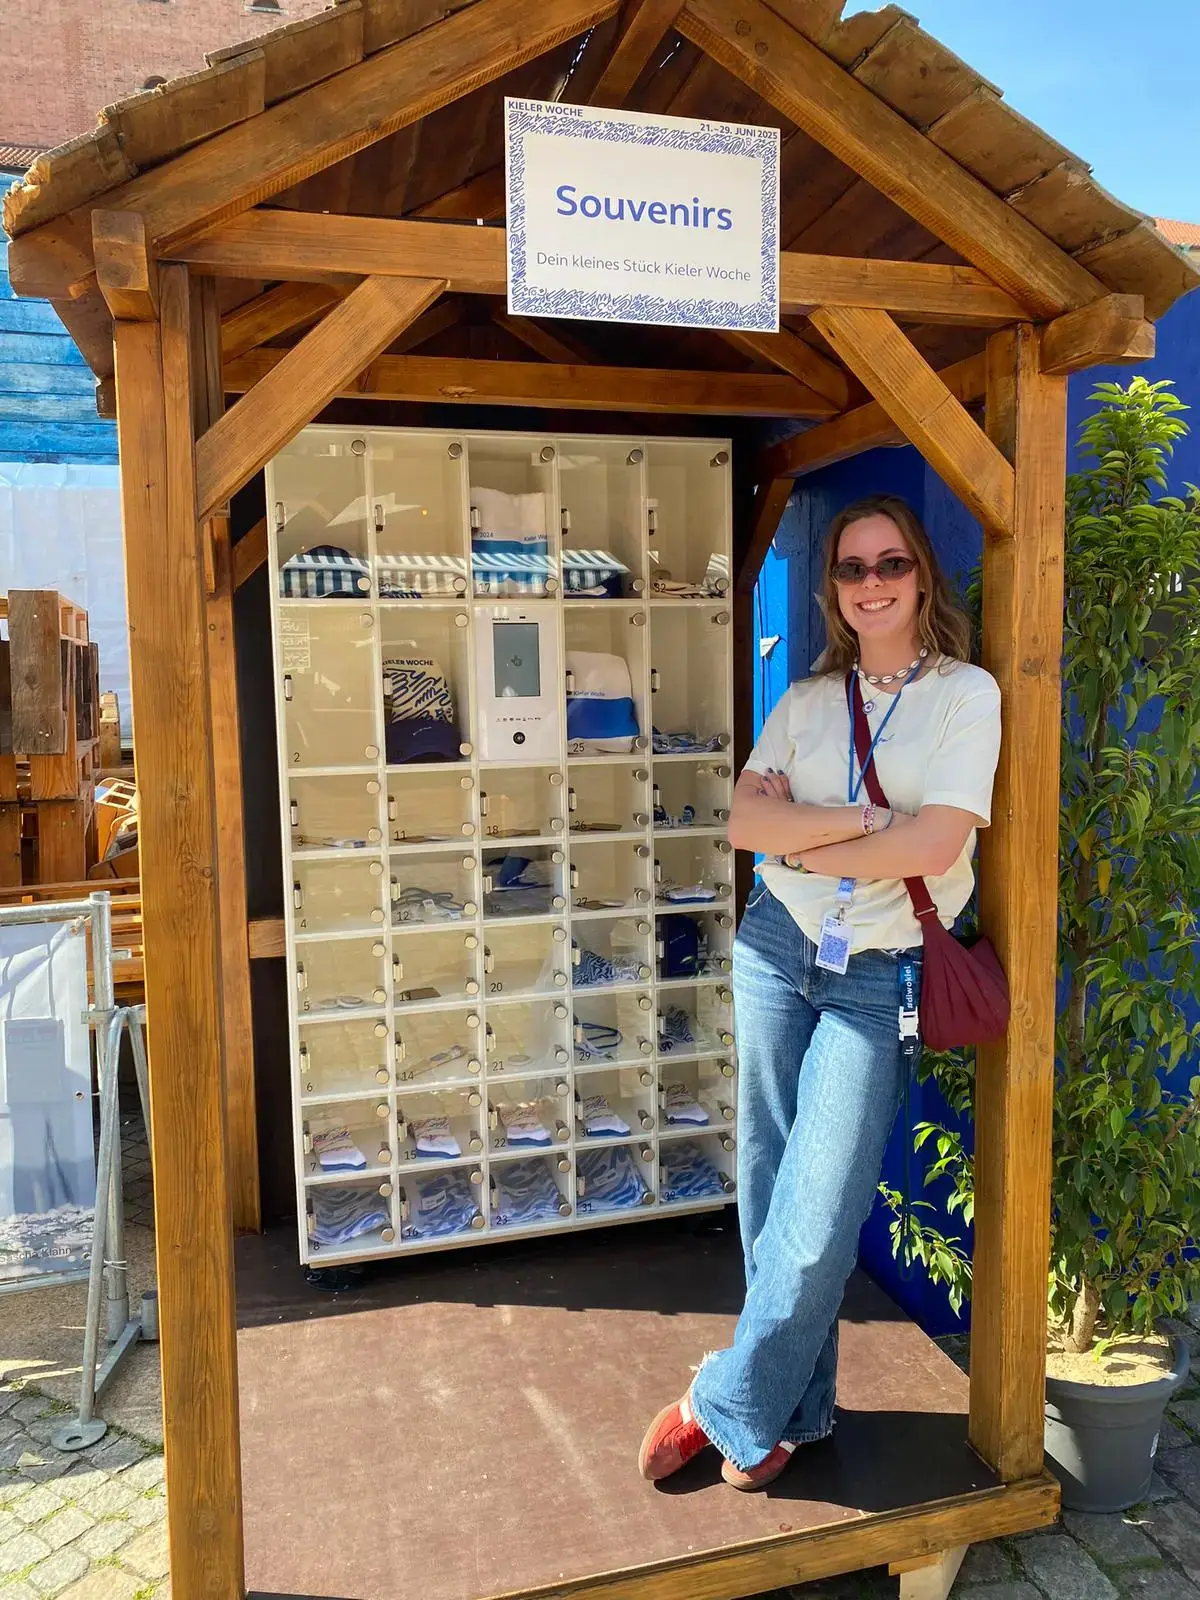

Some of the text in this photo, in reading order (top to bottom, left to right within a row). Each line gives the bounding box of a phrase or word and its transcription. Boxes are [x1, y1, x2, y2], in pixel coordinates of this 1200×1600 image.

[508, 100, 584, 117] KIELER WOCHE
[735, 127, 756, 137] JUNI
[757, 130, 778, 140] 2025
[556, 185, 733, 231] Souvenirs
[536, 251, 751, 281] Dein kleines Stück Kieler Woche
[479, 582, 491, 593] 17
[405, 659, 434, 667] WOCHE
[572, 742, 585, 753] 25
[293, 752, 300, 763] 2
[487, 825, 500, 835] 18
[575, 820, 587, 831] 26
[394, 830, 407, 841] 11
[297, 836, 304, 847] 3
[575, 897, 588, 907] 27
[397, 910, 410, 922] 12
[300, 918, 307, 929] 4
[490, 982, 504, 993] 20
[399, 991, 412, 1002] 13
[303, 1000, 311, 1011] 5
[579, 1051, 591, 1061] 29
[492, 1060, 505, 1071] 21
[401, 1071, 414, 1082] 14
[306, 1081, 313, 1093] 6
[494, 1137, 507, 1148] 22
[404, 1150, 417, 1161] 15
[310, 1162, 317, 1172] 7
[582, 1203, 592, 1213] 31
[496, 1214, 509, 1226] 23
[406, 1226, 418, 1237] 16
[313, 1240, 320, 1251] 8
[41, 1246, 72, 1257] Klahn
